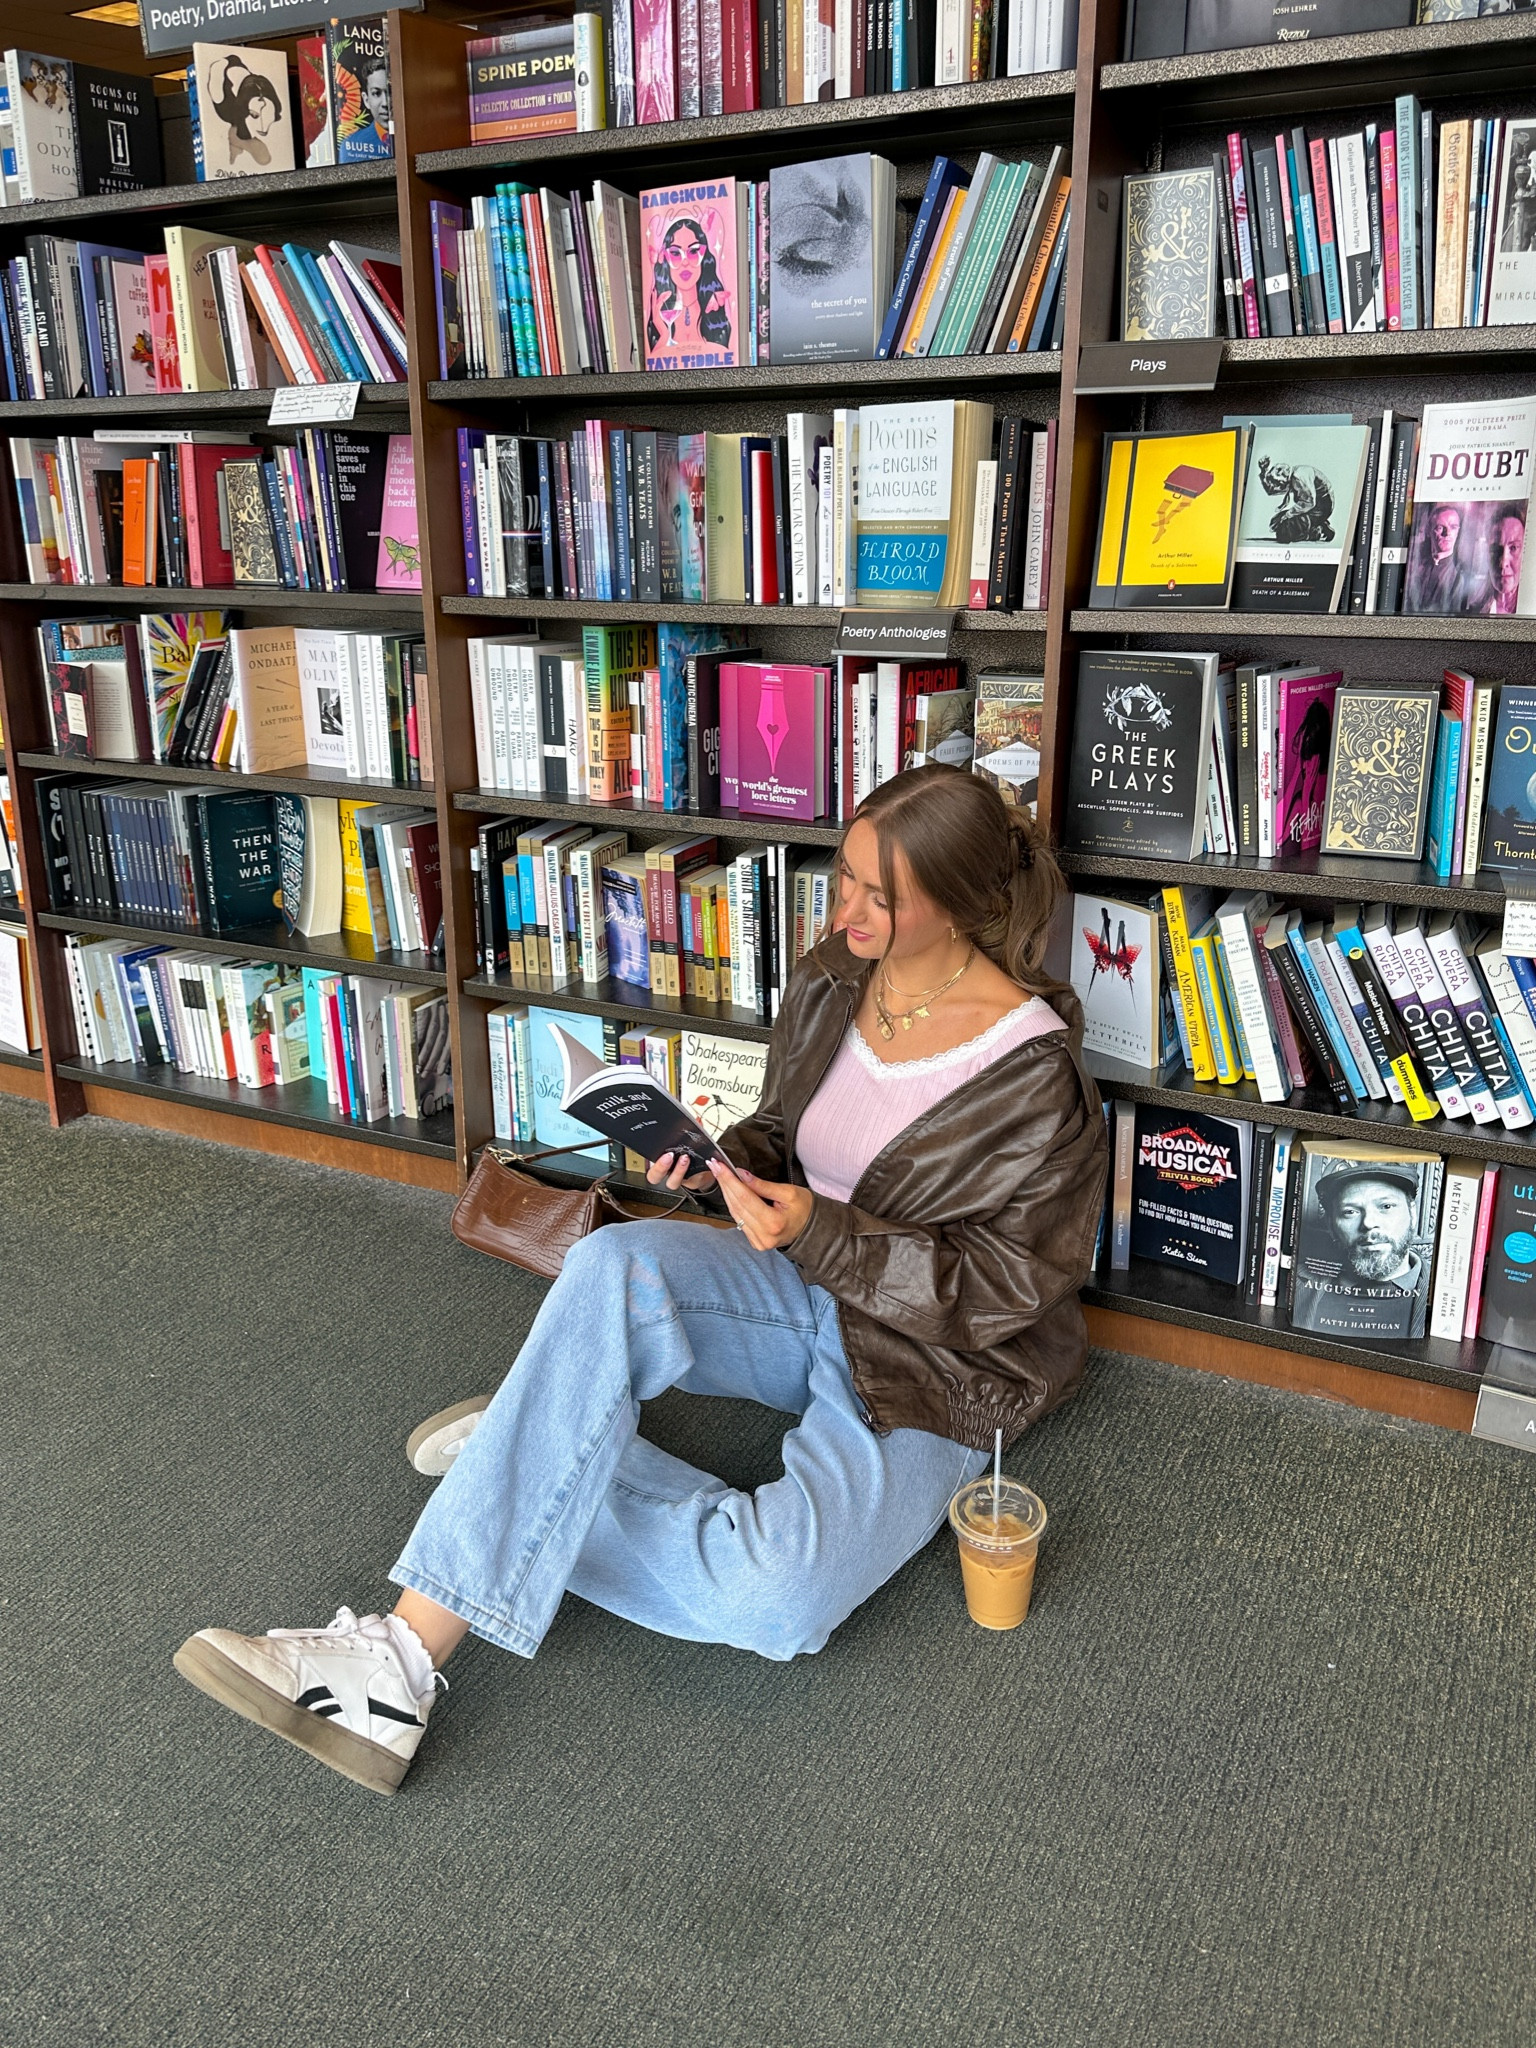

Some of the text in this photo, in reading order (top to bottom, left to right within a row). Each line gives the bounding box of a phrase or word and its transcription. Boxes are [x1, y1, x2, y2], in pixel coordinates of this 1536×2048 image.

[151, 3, 205, 30] Poetry,
[208, 0, 267, 20] Drama,
[1272, 4, 1318, 15] JOSH LEHRER
[477, 53, 575, 83] SPINE POEM
[90, 83, 138, 101] ROOMS OF
[91, 97, 140, 116] THE MIND
[346, 141, 389, 155] BLUES IN
[1383, 146, 1392, 161] Eve
[1400, 105, 1412, 310] THE ACTOR'S LIFE JENNA FISCHER
[892, 219, 926, 310] Every Word You Cannot Say
[1499, 261, 1519, 271] THE
[36, 311, 49, 347] ISLAND
[1130, 358, 1167, 373] Plays
[883, 415, 936, 425] THE BEST
[1443, 413, 1527, 426] 2005 PULITZER PRIZE
[1482, 424, 1507, 432] DRAMA
[334, 434, 348, 443] the
[869, 419, 937, 451] Poems
[81, 444, 103, 454] shine
[335, 444, 370, 455] princess
[336, 454, 358, 463] saves
[392, 444, 406, 453] she
[82, 456, 100, 467] your
[337, 463, 366, 473] herself
[390, 465, 405, 475] the
[824, 455, 832, 485] POETRY
[883, 456, 938, 474] ENGLISH
[1427, 449, 1530, 481] DOUBT
[339, 483, 356, 492] this
[389, 476, 415, 485] moon
[389, 485, 409, 496] back
[866, 480, 938, 499] LANGUAGE
[341, 493, 355, 501] one
[1002, 491, 1012, 522] Poems
[1028, 442, 1045, 588] 100 POETS JOHN CAREY
[1000, 525, 1009, 547] That
[860, 541, 940, 563] HAROLD
[868, 565, 929, 585] BLOOM
[996, 550, 1006, 584] Matter
[662, 582, 683, 593] YEATS
[1263, 576, 1284, 584] ARTHUR
[841, 626, 947, 641] Poetry Anthologies
[250, 640, 297, 655] MICHAEL
[608, 628, 648, 670] THIS IS
[249, 655, 296, 670] ONDAATJ
[687, 660, 697, 727] GIGANTIC CINEMA
[906, 667, 958, 699] AFRICAN
[1290, 680, 1339, 695] PHOEBE WALLER-BRIDGE
[260, 715, 303, 727] LAST THINGS
[1475, 694, 1489, 767] YUKIO MISHIMA
[311, 737, 345, 751] Devoti
[568, 718, 578, 757] HAIKU
[1124, 731, 1147, 742] THE
[988, 758, 1012, 766] POEMS
[1091, 743, 1176, 769] GREEK
[742, 781, 808, 796] world's greatest
[1090, 768, 1174, 794] PLAYS
[232, 834, 272, 849] THEN
[239, 850, 269, 863] THE
[239, 864, 272, 879] WAR
[666, 889, 674, 924] OTHELLO
[741, 864, 754, 945] SONIA SANCHEZ
[1162, 932, 1177, 978] SOPHOCLES
[1385, 944, 1405, 979] CHITA
[1336, 950, 1358, 996] CHITA RIVERA
[1373, 945, 1397, 987] RIVERA
[1402, 948, 1426, 990] RIVERA
[1414, 948, 1435, 984] CHITA
[1438, 950, 1461, 992] RIVERA
[1450, 949, 1470, 986] CHITA
[1307, 968, 1321, 992] HANSEN
[1487, 962, 1528, 1017] SHY
[1177, 969, 1200, 1048] AMERICAN UTOPIA
[1364, 981, 1390, 1036] Musical Theatre
[1362, 1016, 1388, 1065] CHITA
[1402, 1004, 1450, 1083] CHITA
[1431, 1010, 1478, 1088] CHITA
[1465, 1011, 1511, 1091] CHITA
[685, 1034, 768, 1069] Shakespeare
[706, 1064, 717, 1074] in
[1396, 1058, 1418, 1101] dummies
[686, 1063, 762, 1102] Bloomsbury
[596, 1091, 653, 1112] milk and
[606, 1102, 650, 1120] honey
[1142, 1135, 1230, 1159] BROADWAY
[1138, 1149, 1238, 1179] MUSICAL
[1160, 1171, 1214, 1185] TRIVIA BOOK
[1139, 1198, 1234, 1232] FUN-FILLED FACTS & TRIVIA QUESTIONS
[1268, 1186, 1284, 1242] IMPROVISE.
[1449, 1181, 1462, 1231] METHOD
[1138, 1206, 1234, 1240] TO FIND OUT HOW MUCH YOU REALLY KNOW!
[1504, 1267, 1533, 1280] expanded
[1508, 1275, 1528, 1284] edition
[1304, 1279, 1421, 1299] AUGUST WILSON
[1320, 1317, 1400, 1331] PATTI HARTIGAN
